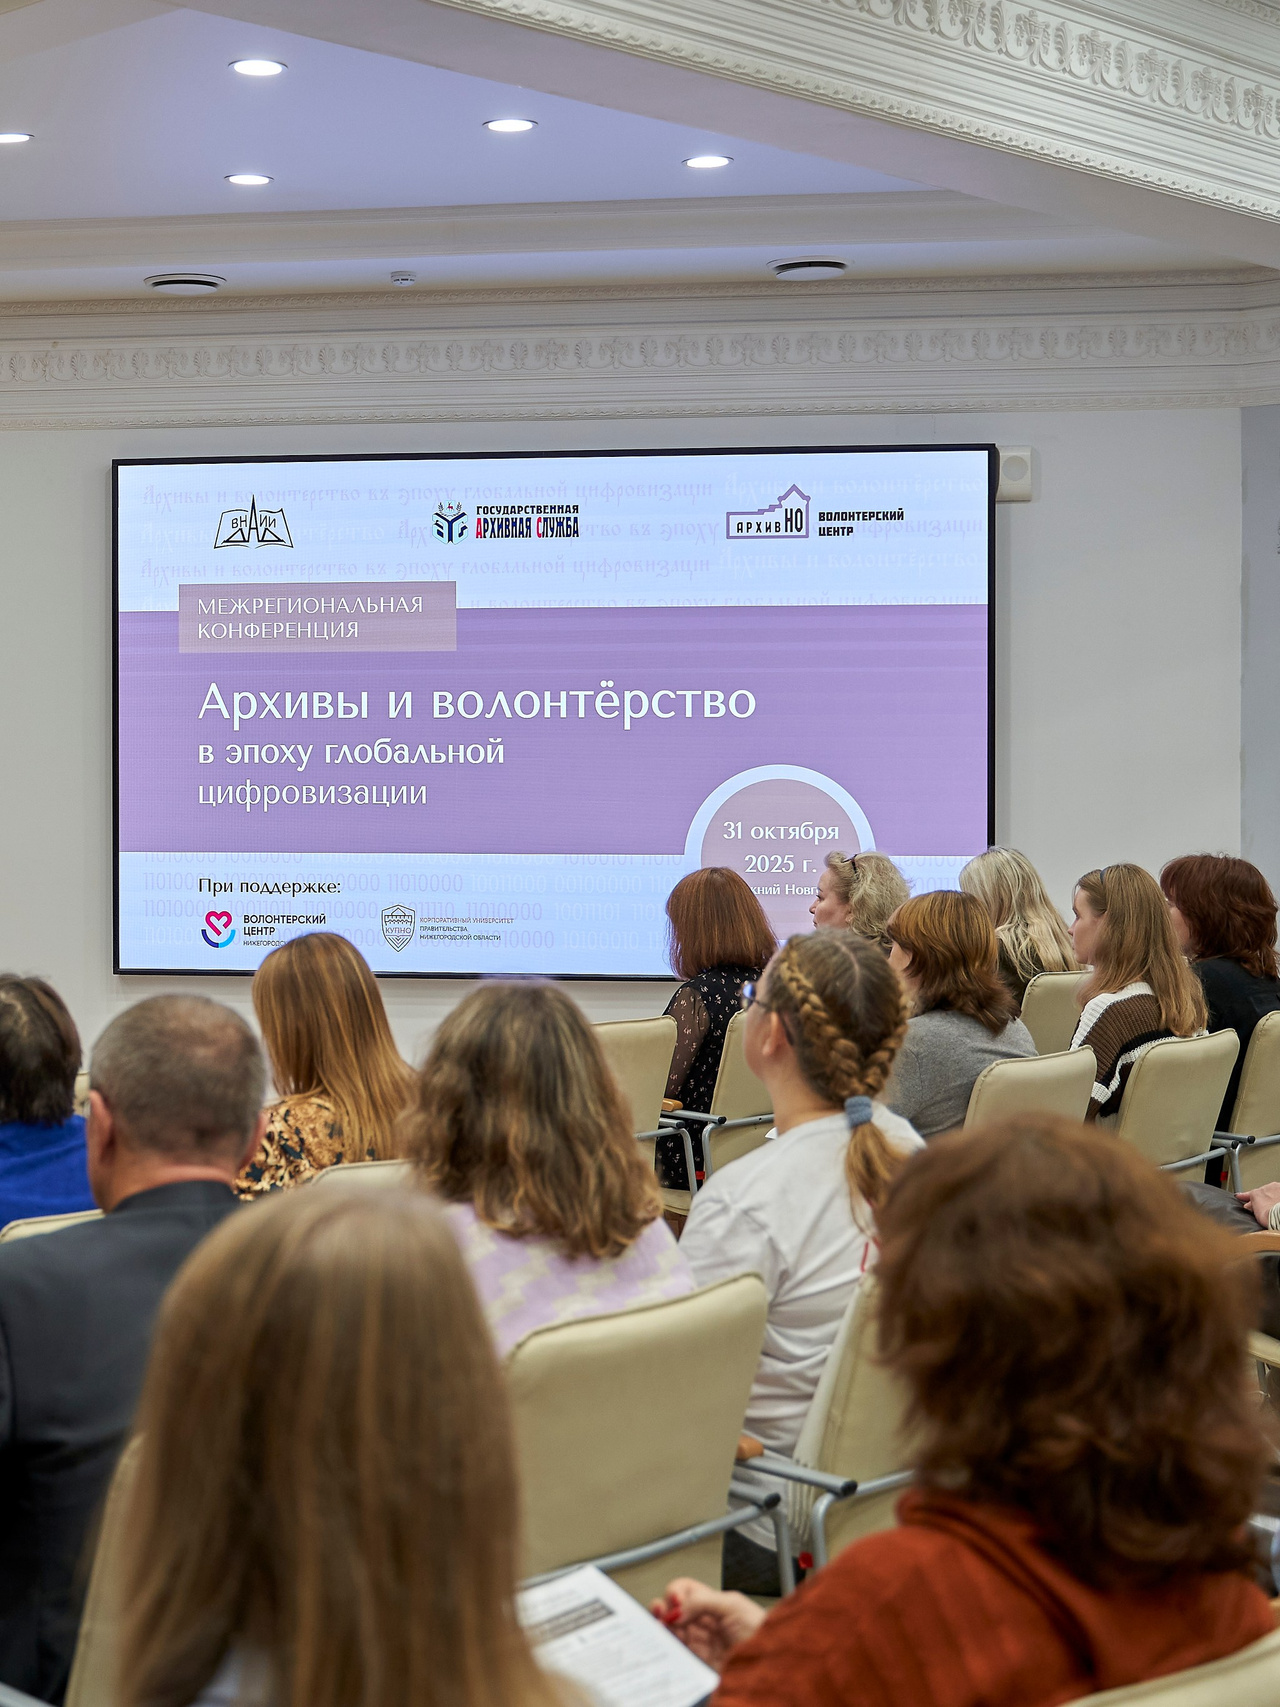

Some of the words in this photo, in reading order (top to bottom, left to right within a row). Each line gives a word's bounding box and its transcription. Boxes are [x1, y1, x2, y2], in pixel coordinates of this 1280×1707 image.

[476, 505, 579, 516] ГОСУДАРСТВЕННАЯ
[818, 508, 904, 522] ВОЛОНТЕРСКИЙ
[475, 517, 532, 539] АРХИВНАЯ
[536, 516, 580, 539] СЛУЖБА
[818, 527, 854, 537] ЦЕНТР
[198, 596, 423, 616] МЕЖРЕГИОНАЛЬНАЯ
[198, 621, 359, 641] КОНФЕРЕНЦИЯ
[198, 683, 368, 730] Архивы
[388, 691, 412, 719] и
[433, 680, 756, 730] волонтёрство
[198, 744, 215, 764] в
[225, 744, 314, 772] эпоху
[325, 737, 504, 764] глобальной
[198, 778, 427, 812] цифровизации
[723, 821, 742, 839] 31
[750, 821, 839, 846] октября
[744, 854, 795, 873] 2025
[802, 859, 817, 873] г.
[198, 878, 233, 898] При
[240, 882, 342, 898] поддержке:
[243, 912, 327, 925] ВОЛОНТЕРСКИЙ
[243, 927, 276, 938] ЦЕНТР
